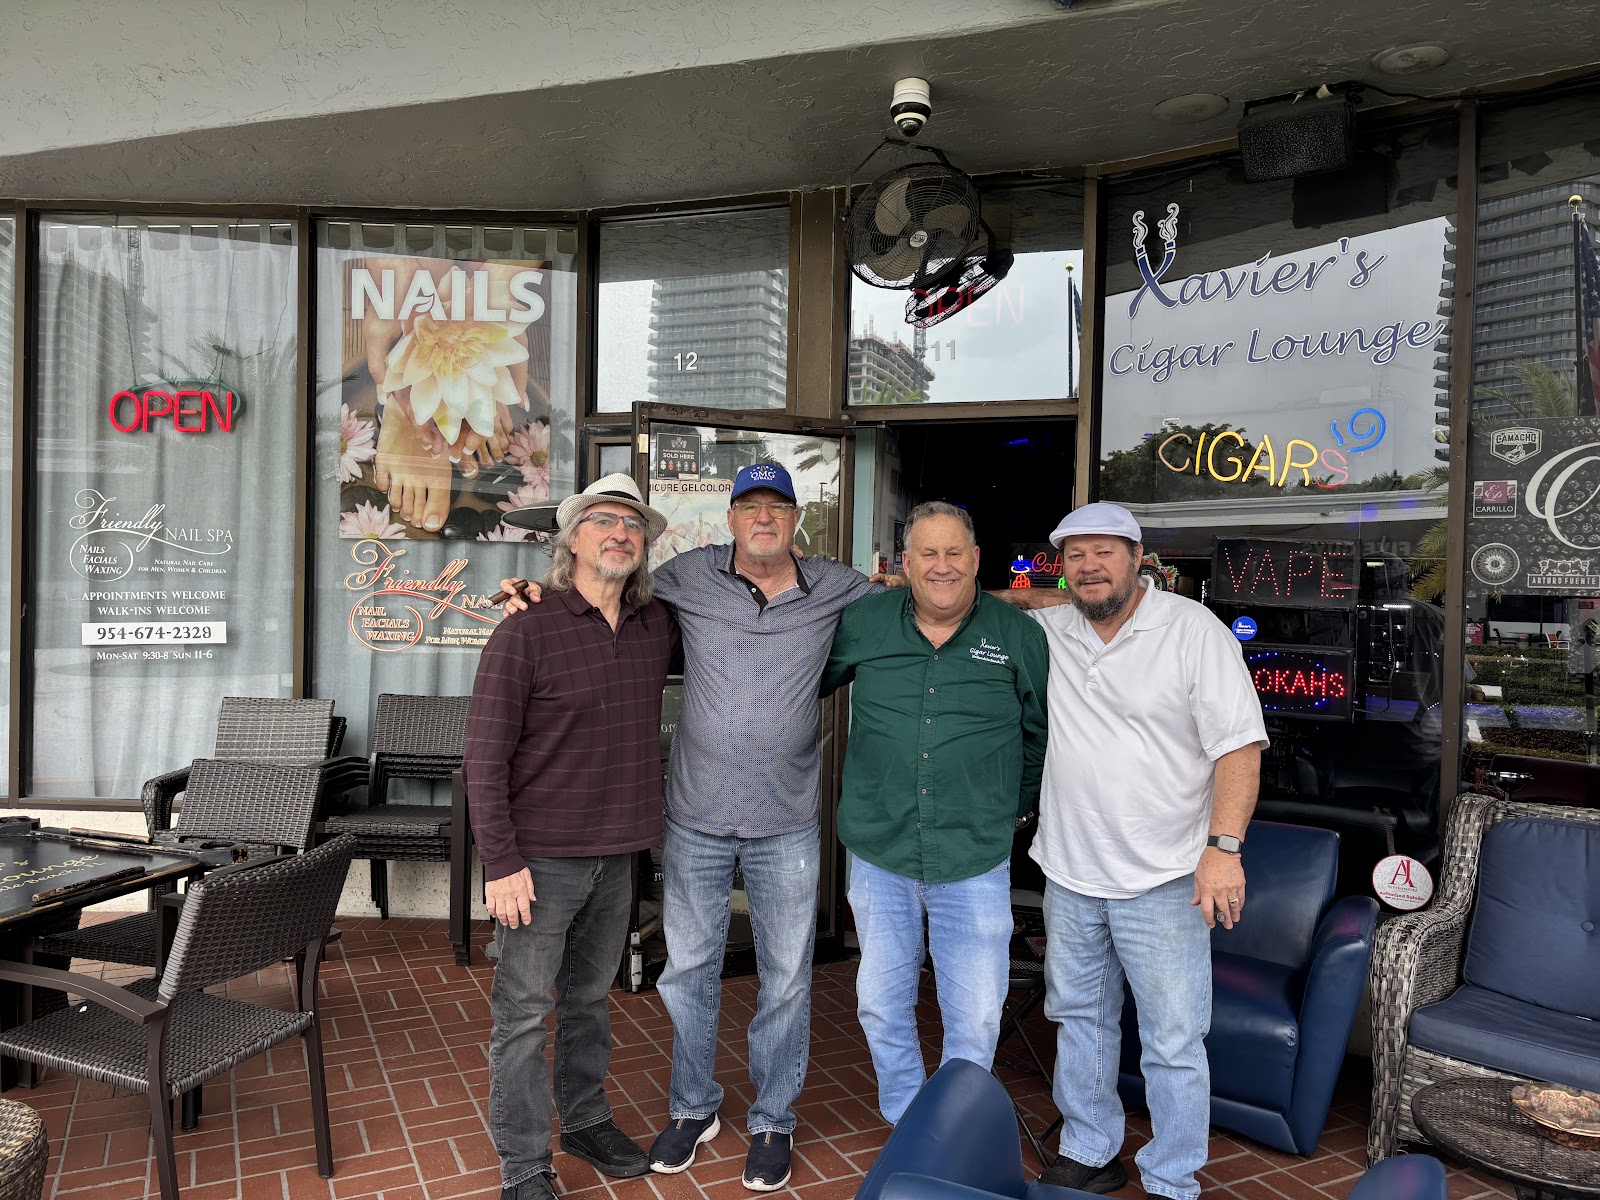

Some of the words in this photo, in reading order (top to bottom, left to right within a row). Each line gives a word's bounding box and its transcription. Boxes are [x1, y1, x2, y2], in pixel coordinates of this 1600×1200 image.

[1127, 237, 1387, 319] Xavier's
[351, 268, 545, 322] NAILS
[931, 339, 956, 361] 11
[1108, 337, 1236, 384] Cigar
[1245, 320, 1446, 365] Lounge
[674, 351, 699, 371] 12
[108, 390, 233, 433] OPEN
[1495, 433, 1537, 444] CAMACHO
[1158, 431, 1349, 489] CIGARS
[750, 470, 776, 479] OMG
[649, 483, 679, 492] ICURE
[681, 483, 731, 492] GELCOLOR
[1475, 505, 1514, 513] CARRILLO
[69, 489, 166, 552] Friendly
[165, 528, 203, 541] NAIL
[207, 528, 234, 542] SPA
[79, 545, 106, 554] NAILS
[83, 554, 118, 564] FACIALS
[1032, 552, 1064, 576] Coff
[85, 565, 123, 575] WAXING
[1224, 547, 1346, 598] VAPE
[344, 539, 469, 620] Friendly
[460, 594, 503, 609] NA
[1531, 576, 1563, 585] ARTURO
[1564, 576, 1597, 585] FUENTE
[82, 591, 168, 601] APPOINTMENTS
[172, 590, 226, 600] WELCOME
[98, 606, 152, 616] WALK-INS
[156, 605, 211, 615] WELCOME
[358, 606, 387, 617] NAIL
[361, 618, 410, 629] FACIALS
[97, 626, 212, 640] 954-674-2328
[365, 631, 415, 641] WAXING
[194, 650, 213, 659] 11-6
[1254, 667, 1345, 697] OKAHS
[0, 854, 99, 884] ounge
